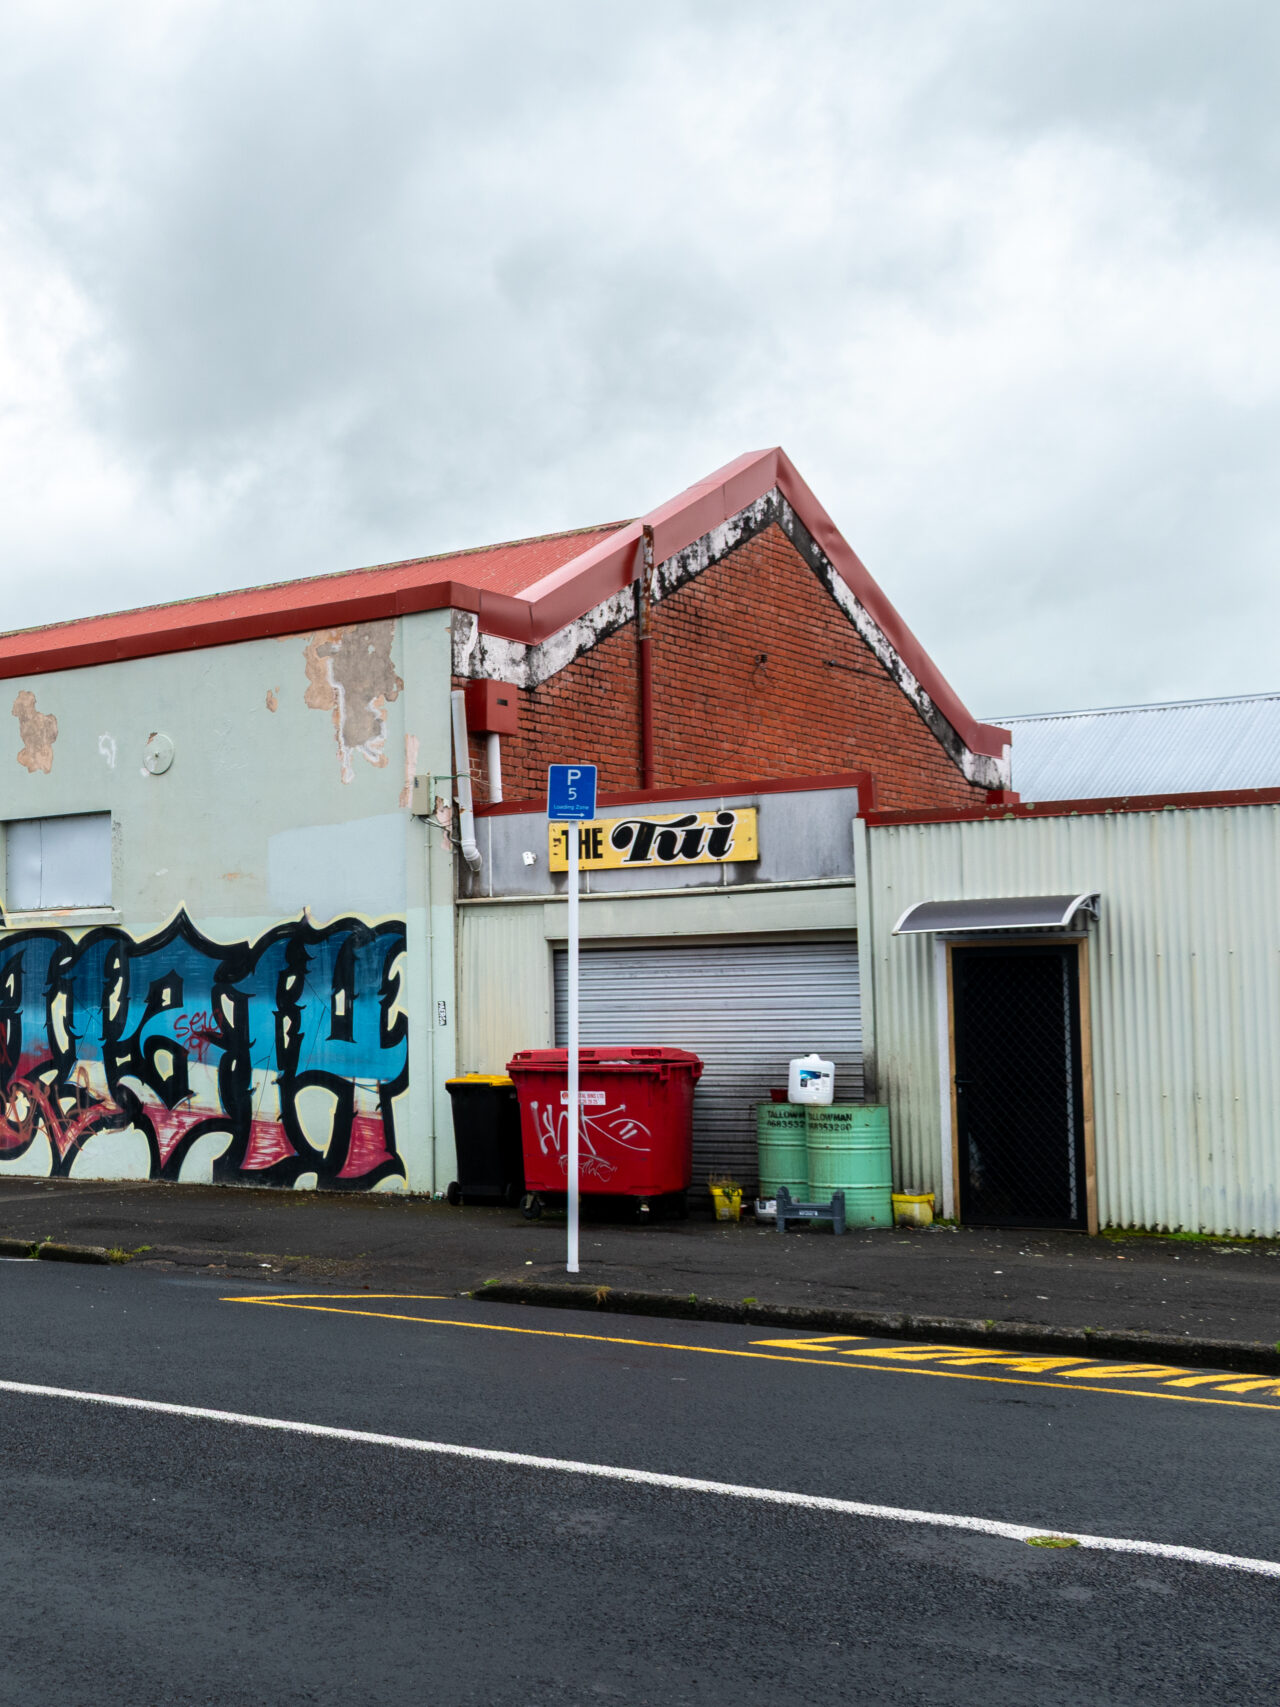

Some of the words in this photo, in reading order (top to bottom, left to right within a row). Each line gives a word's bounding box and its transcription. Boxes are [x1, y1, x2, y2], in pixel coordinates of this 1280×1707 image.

[567, 769, 582, 786] P
[568, 787, 578, 801] 5
[561, 827, 603, 861] THE
[611, 812, 736, 863] Tui
[767, 1110, 806, 1119] TALLOWM
[807, 1112, 853, 1121] ALLOWMAN
